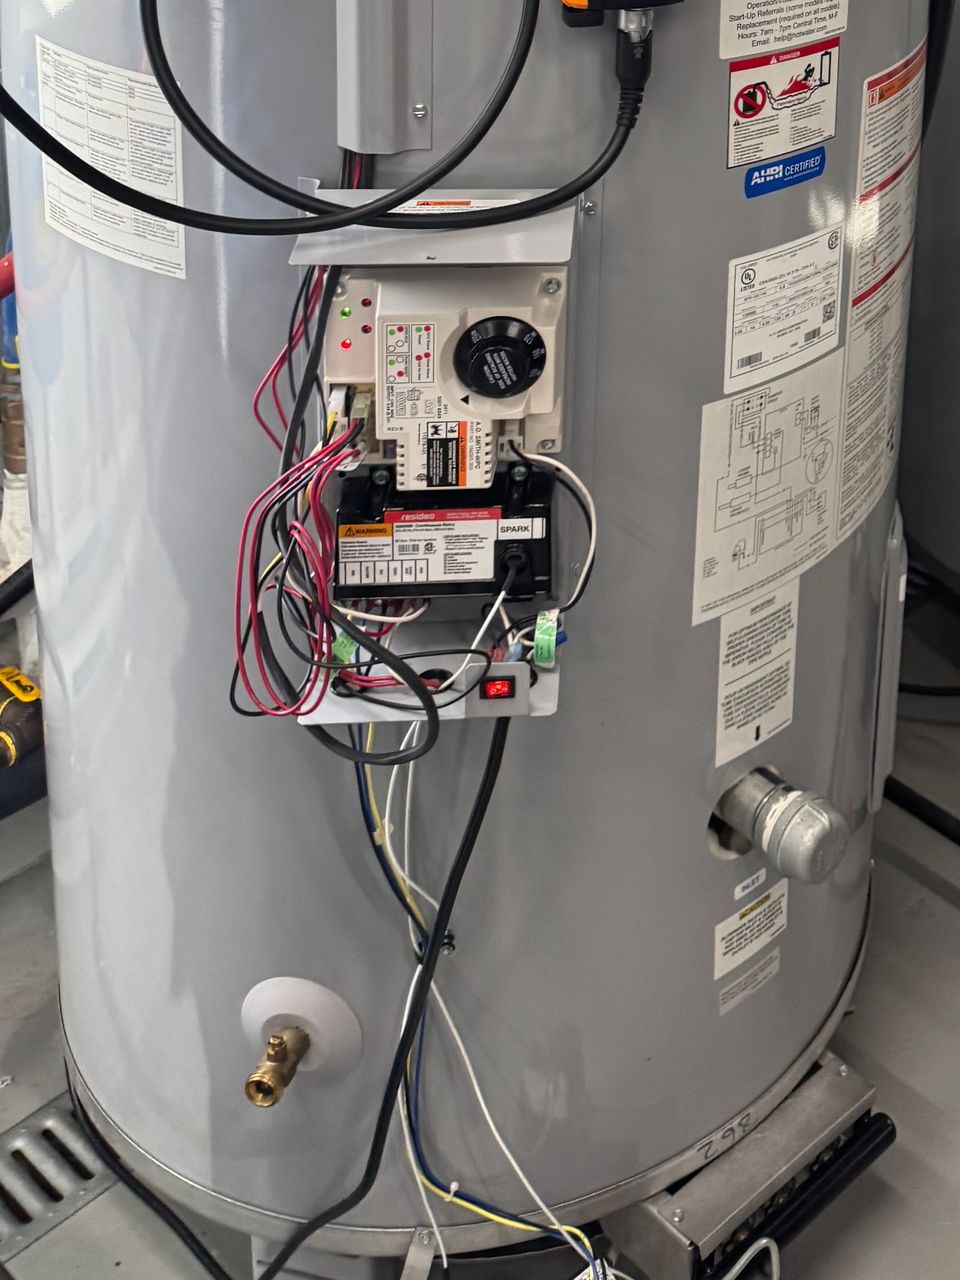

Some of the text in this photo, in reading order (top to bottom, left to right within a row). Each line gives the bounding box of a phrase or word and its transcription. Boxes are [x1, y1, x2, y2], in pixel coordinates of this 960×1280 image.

[728, 11, 756, 23] Start-Up
[757, 6, 785, 18] Referrals
[785, 2, 804, 13] (some
[736, 16, 778, 31] Replacement
[778, 11, 804, 24] (required
[820, 1, 840, 13] models)
[737, 31, 758, 41] Hours:
[760, 28, 774, 36] 7am
[779, 23, 791, 33] 7pm
[792, 19, 813, 30] Central
[828, 11, 839, 20] M-F
[751, 39, 770, 48] Email:
[773, 25, 828, 44] help@hotwater.com
[750, 164, 784, 186] AHRI
[740, 283, 755, 293] LISTED
[500, 525, 530, 533] SPARK
